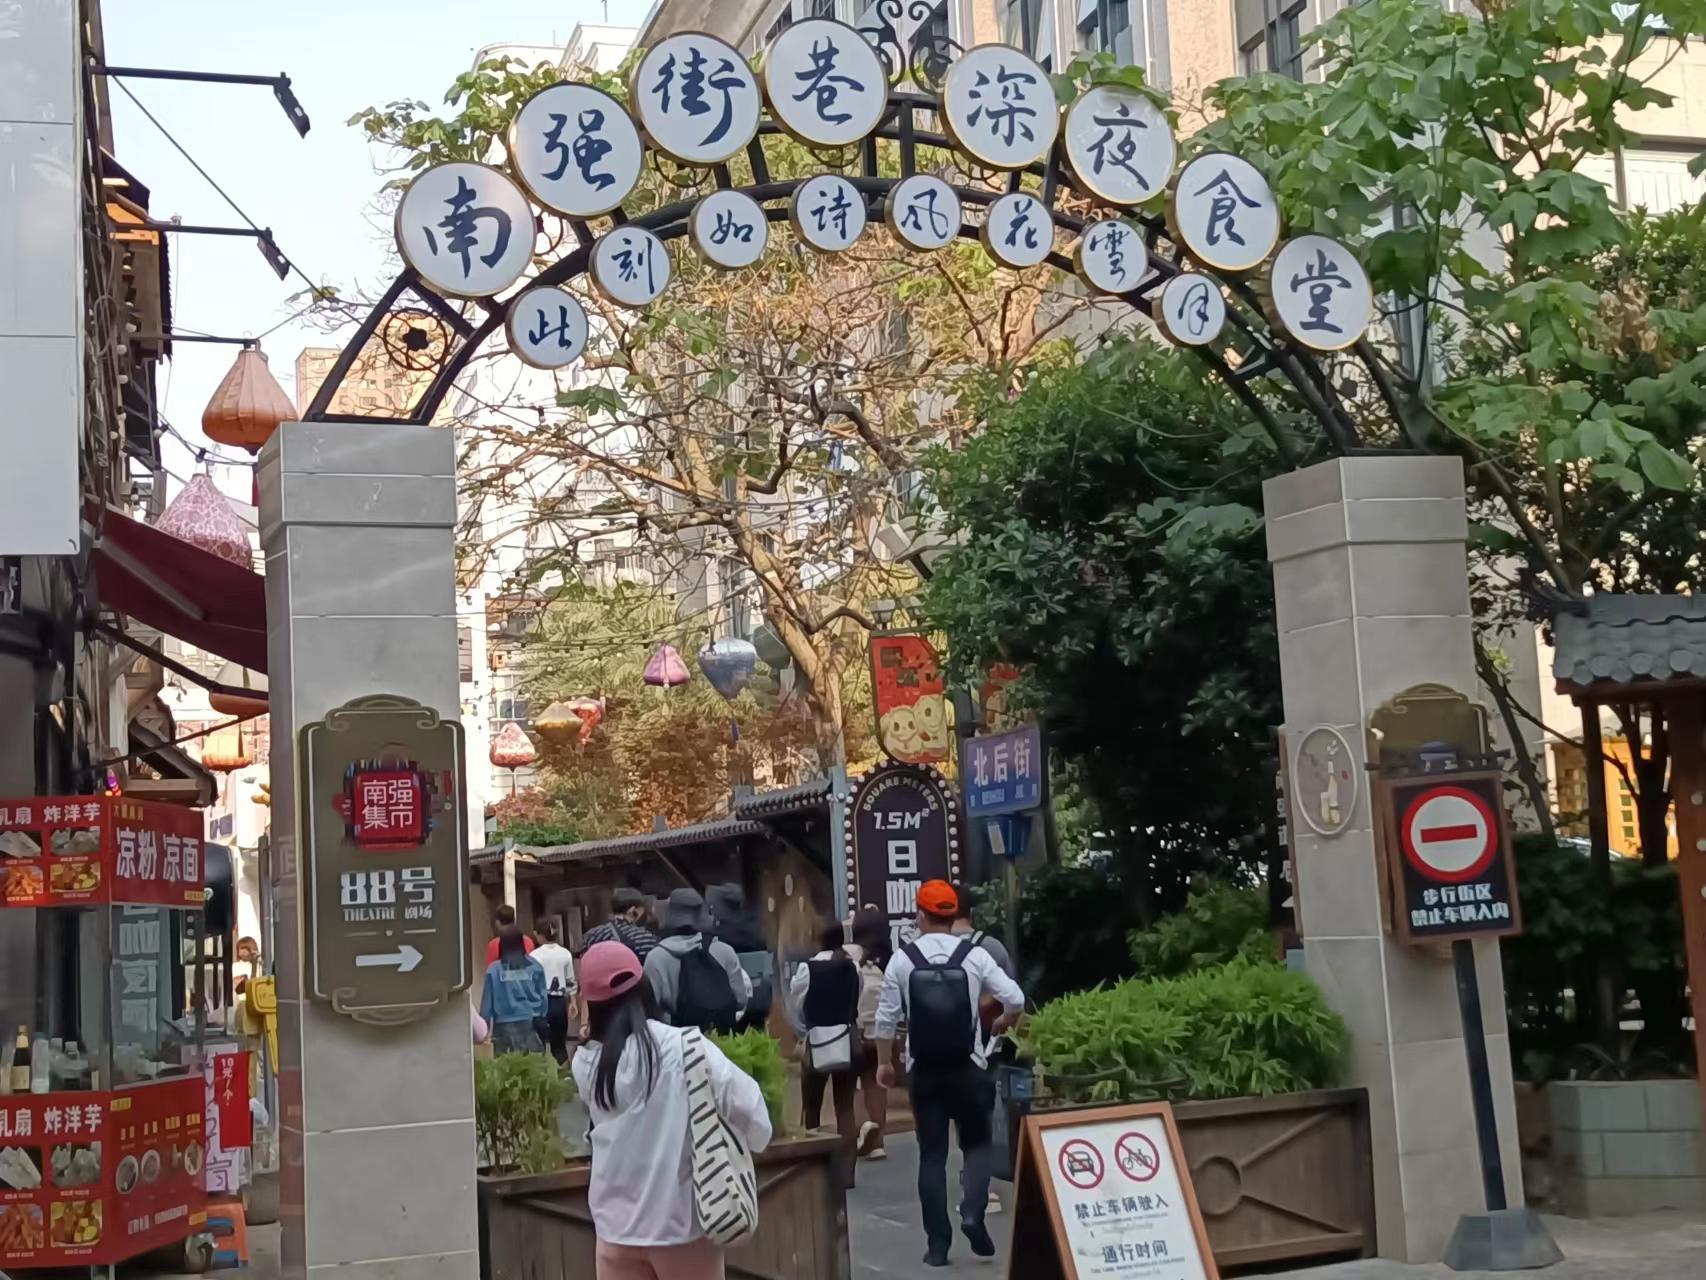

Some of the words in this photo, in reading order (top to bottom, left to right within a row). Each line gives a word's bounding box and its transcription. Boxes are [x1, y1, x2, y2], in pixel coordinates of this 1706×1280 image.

[974, 738, 1030, 788] 北后街
[362, 779, 413, 805] 南强
[863, 776, 899, 811] SQUARE
[903, 777, 938, 811] METERS
[43, 803, 100, 823] 炸洋芋
[362, 804, 414, 829] 集市
[116, 827, 157, 880] 凉粉
[163, 833, 199, 882] 凉面
[1423, 883, 1492, 905] 步行街区
[343, 907, 395, 921] THEATRE
[1411, 902, 1510, 927] 禁止车辆入内
[44, 1104, 102, 1135] 炸洋芋
[1075, 1194, 1168, 1219] 禁止车辆驶入
[1103, 1240, 1168, 1264] 通行时间
